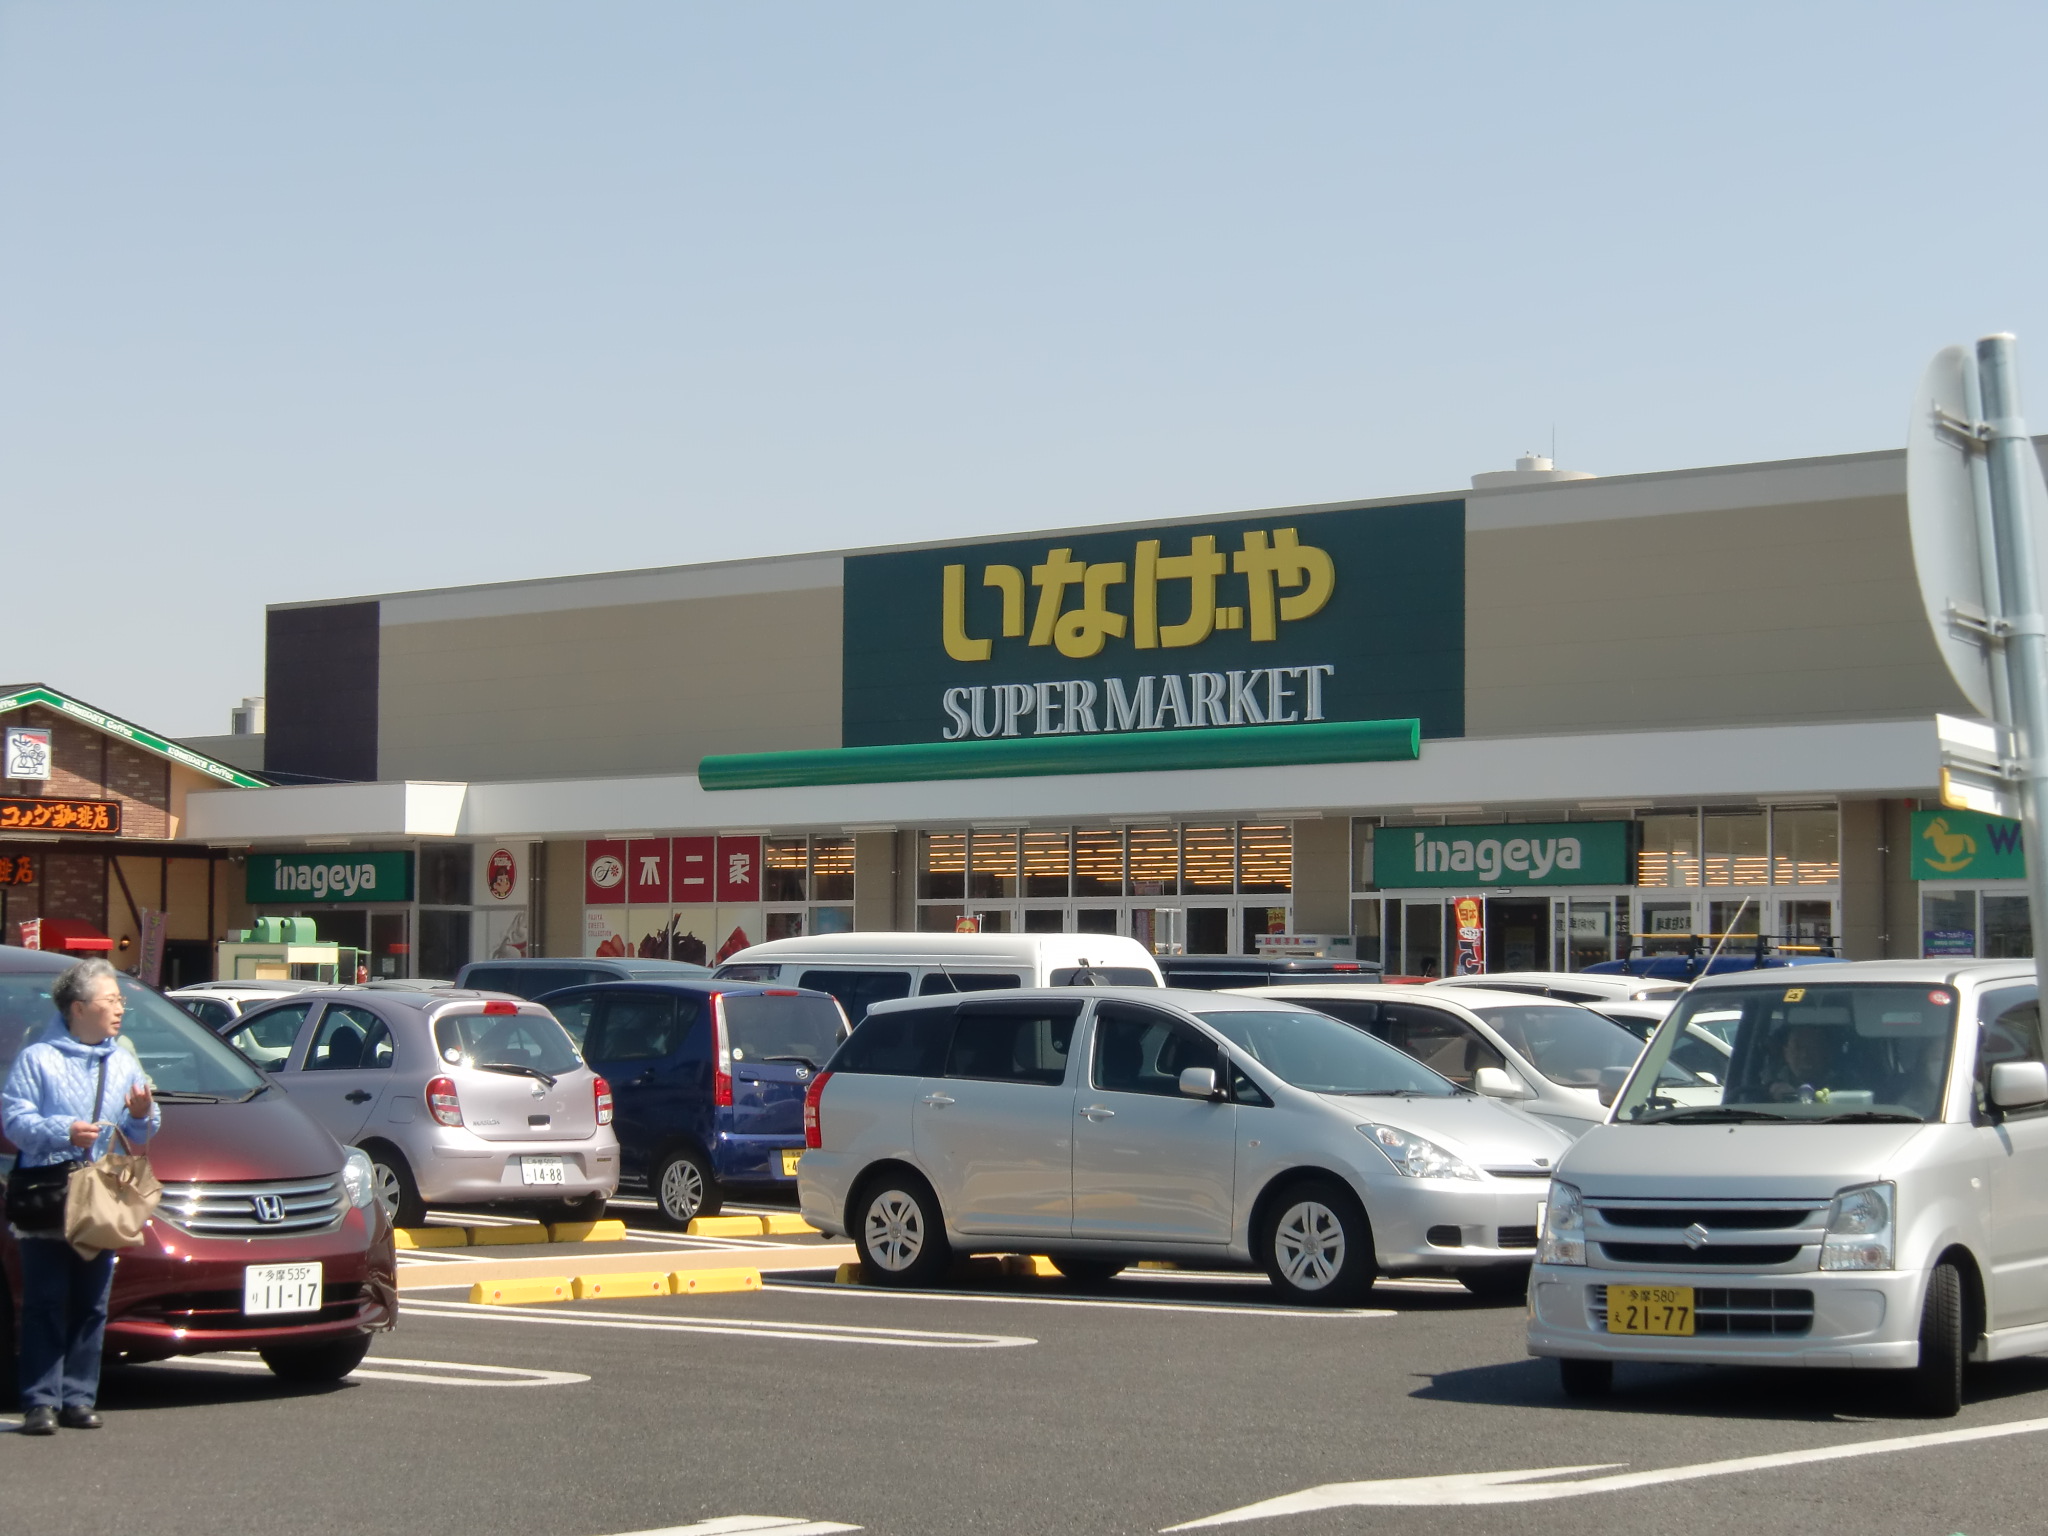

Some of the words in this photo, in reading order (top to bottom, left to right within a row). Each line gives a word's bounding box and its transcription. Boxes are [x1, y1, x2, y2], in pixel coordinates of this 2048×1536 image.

[942, 527, 1335, 662] いなげや
[942, 679, 1100, 739] SUPER
[1104, 664, 1335, 732] MARKET
[1, 804, 109, 829] コメダ珈琲店
[1986, 823, 2025, 855] W
[639, 853, 750, 886] 不二家
[1415, 832, 1581, 881] inageya
[275, 859, 376, 898] inageya
[533, 1168, 562, 1181] 14-88
[265, 1283, 317, 1309] 11-17
[1626, 1305, 1689, 1331] 21-77
